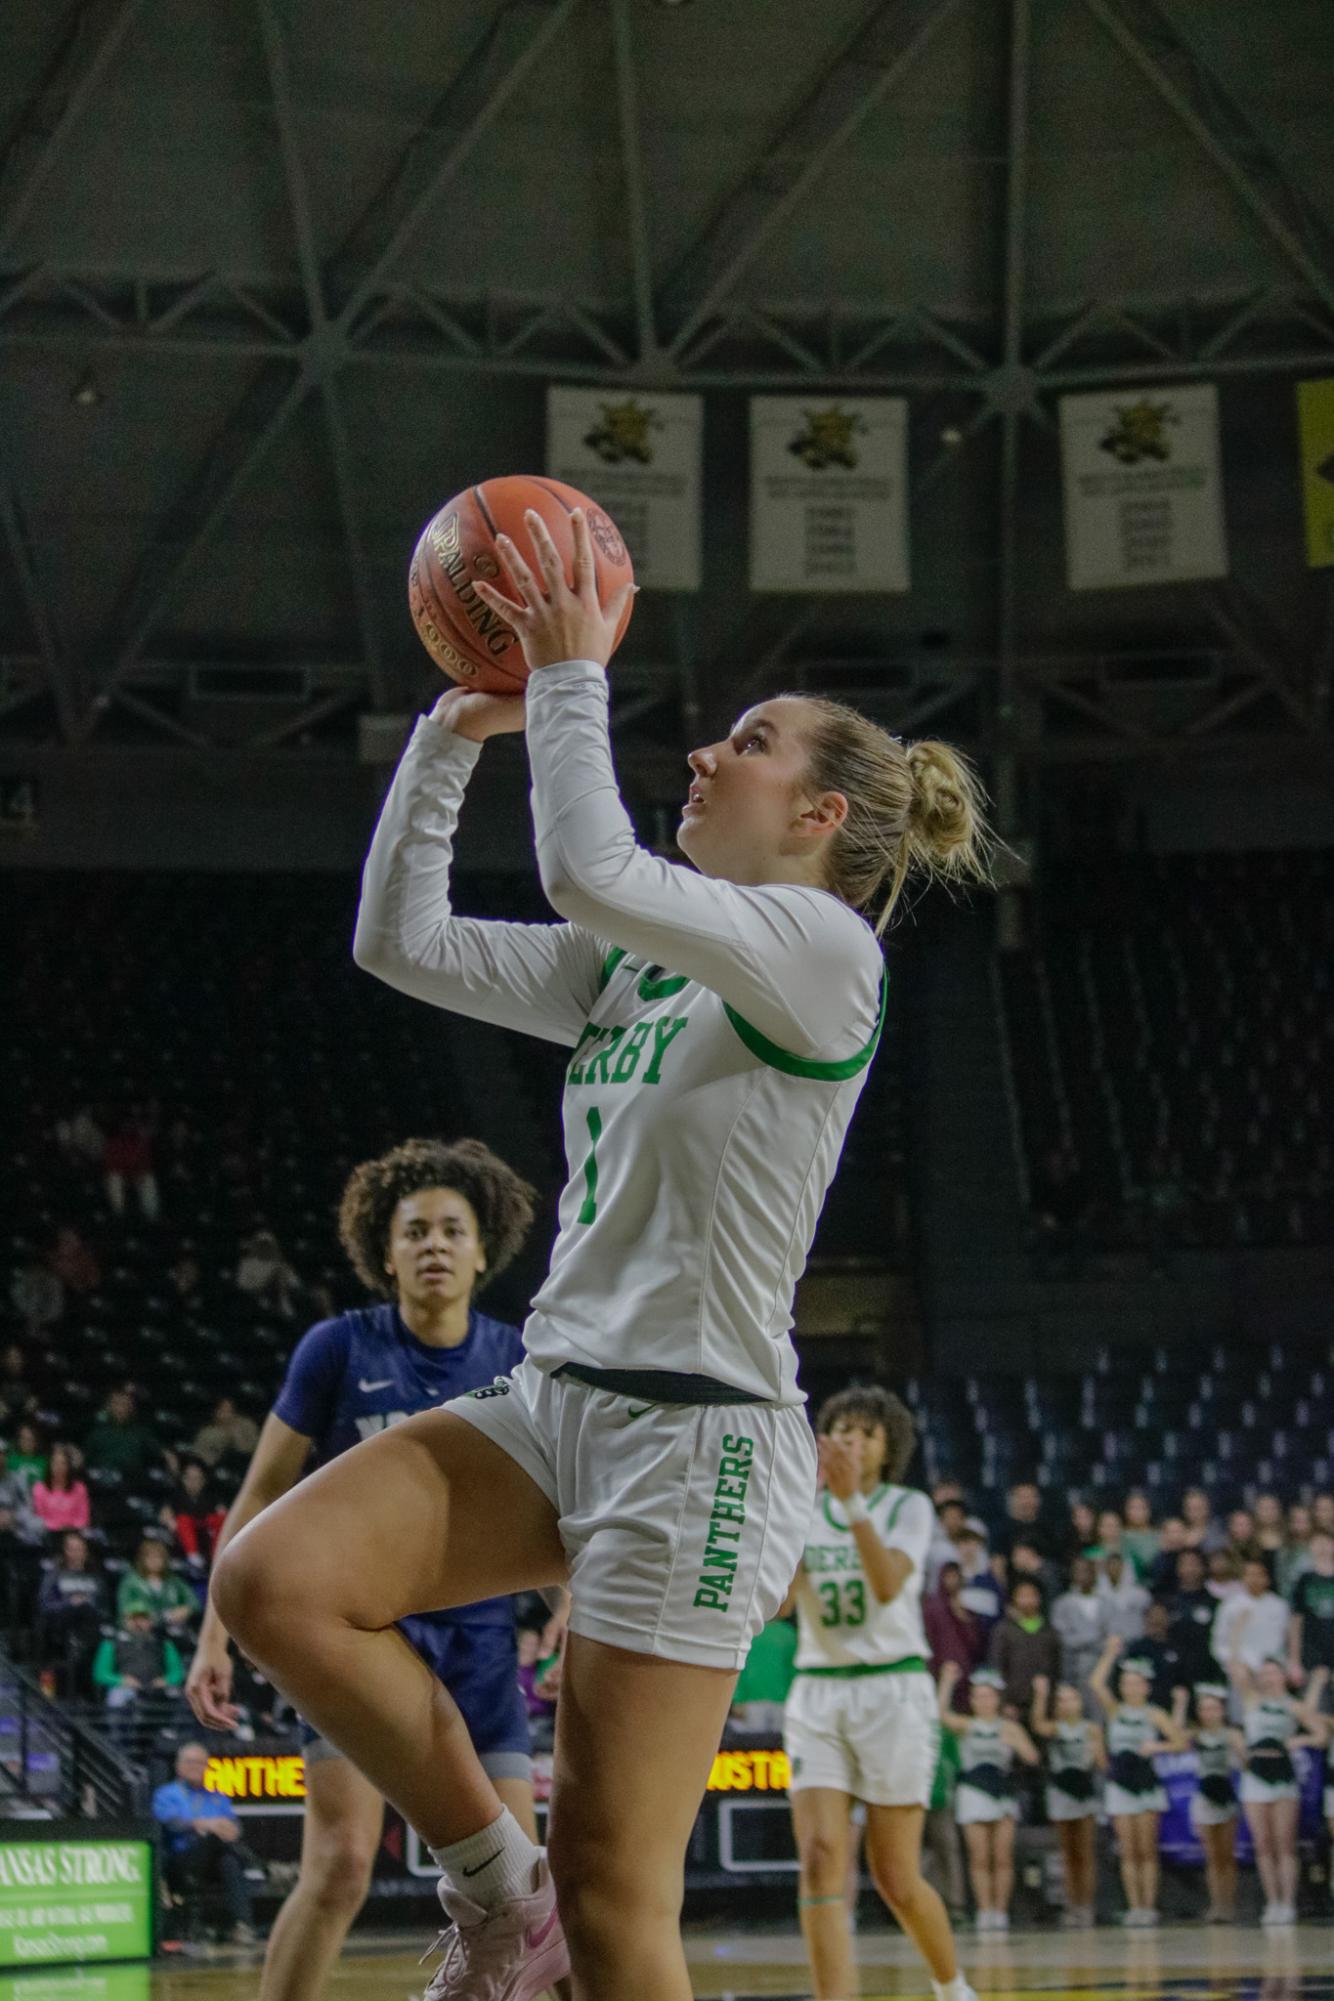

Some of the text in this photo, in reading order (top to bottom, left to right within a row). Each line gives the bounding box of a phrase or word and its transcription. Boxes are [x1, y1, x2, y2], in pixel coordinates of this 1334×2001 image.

[577, 1107, 602, 1225] 1
[693, 1433, 753, 1613] PANTHERS
[818, 1579, 867, 1628] 33
[60, 1845, 142, 1884] STRONG
